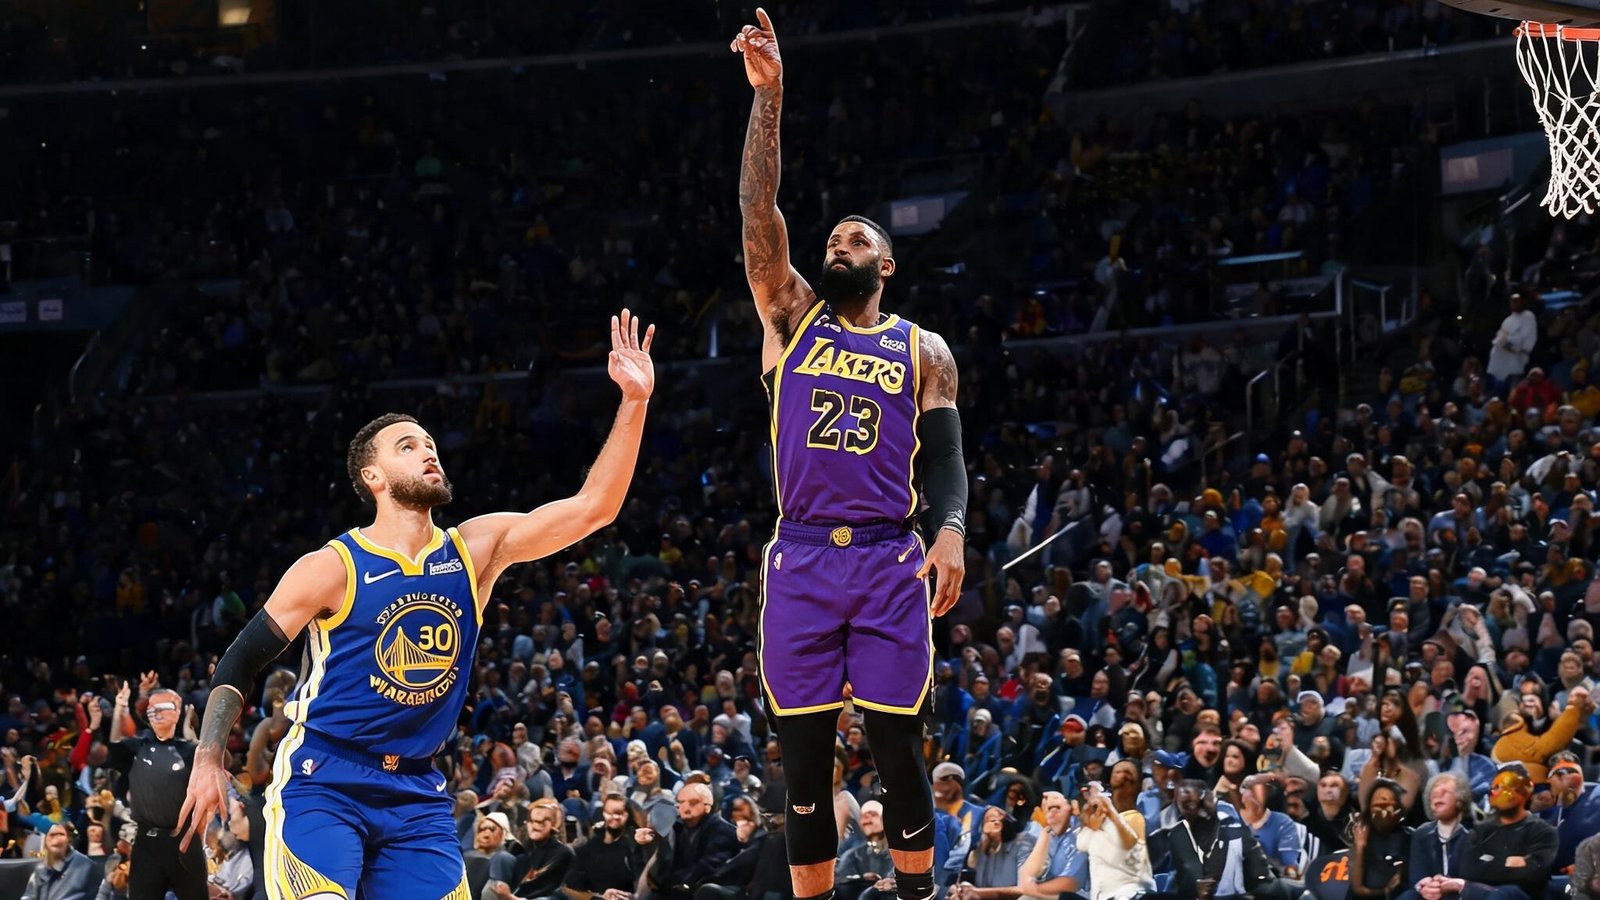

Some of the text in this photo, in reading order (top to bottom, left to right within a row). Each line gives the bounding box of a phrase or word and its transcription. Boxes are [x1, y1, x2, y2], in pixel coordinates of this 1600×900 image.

[793, 336, 906, 394] LAKERS
[807, 388, 882, 455] 23
[418, 623, 453, 651] 30
